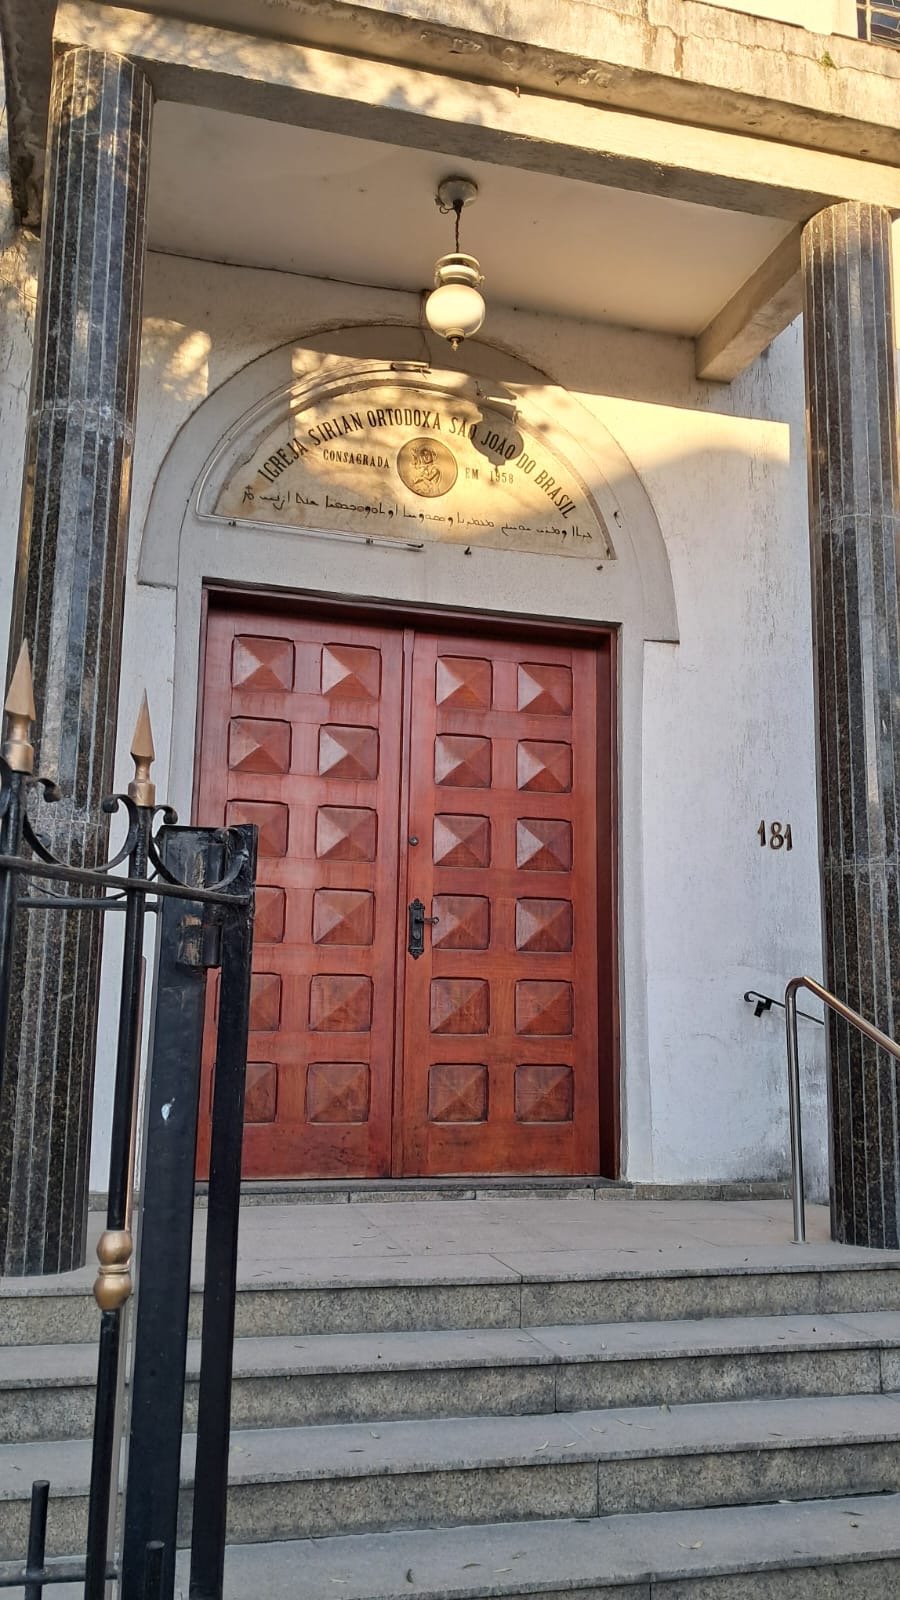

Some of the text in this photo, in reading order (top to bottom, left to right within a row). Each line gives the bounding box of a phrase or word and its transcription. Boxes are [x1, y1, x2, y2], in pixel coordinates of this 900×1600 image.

[257, 437, 309, 483] IGREJA
[308, 411, 364, 447] SIRIAN
[366, 408, 441, 430] ORTODOXA
[515, 452, 537, 474] DO
[533, 470, 577, 519] BRASIL
[323, 448, 514, 484] CONSAGRADA EM 1958
[757, 819, 793, 851] 181
